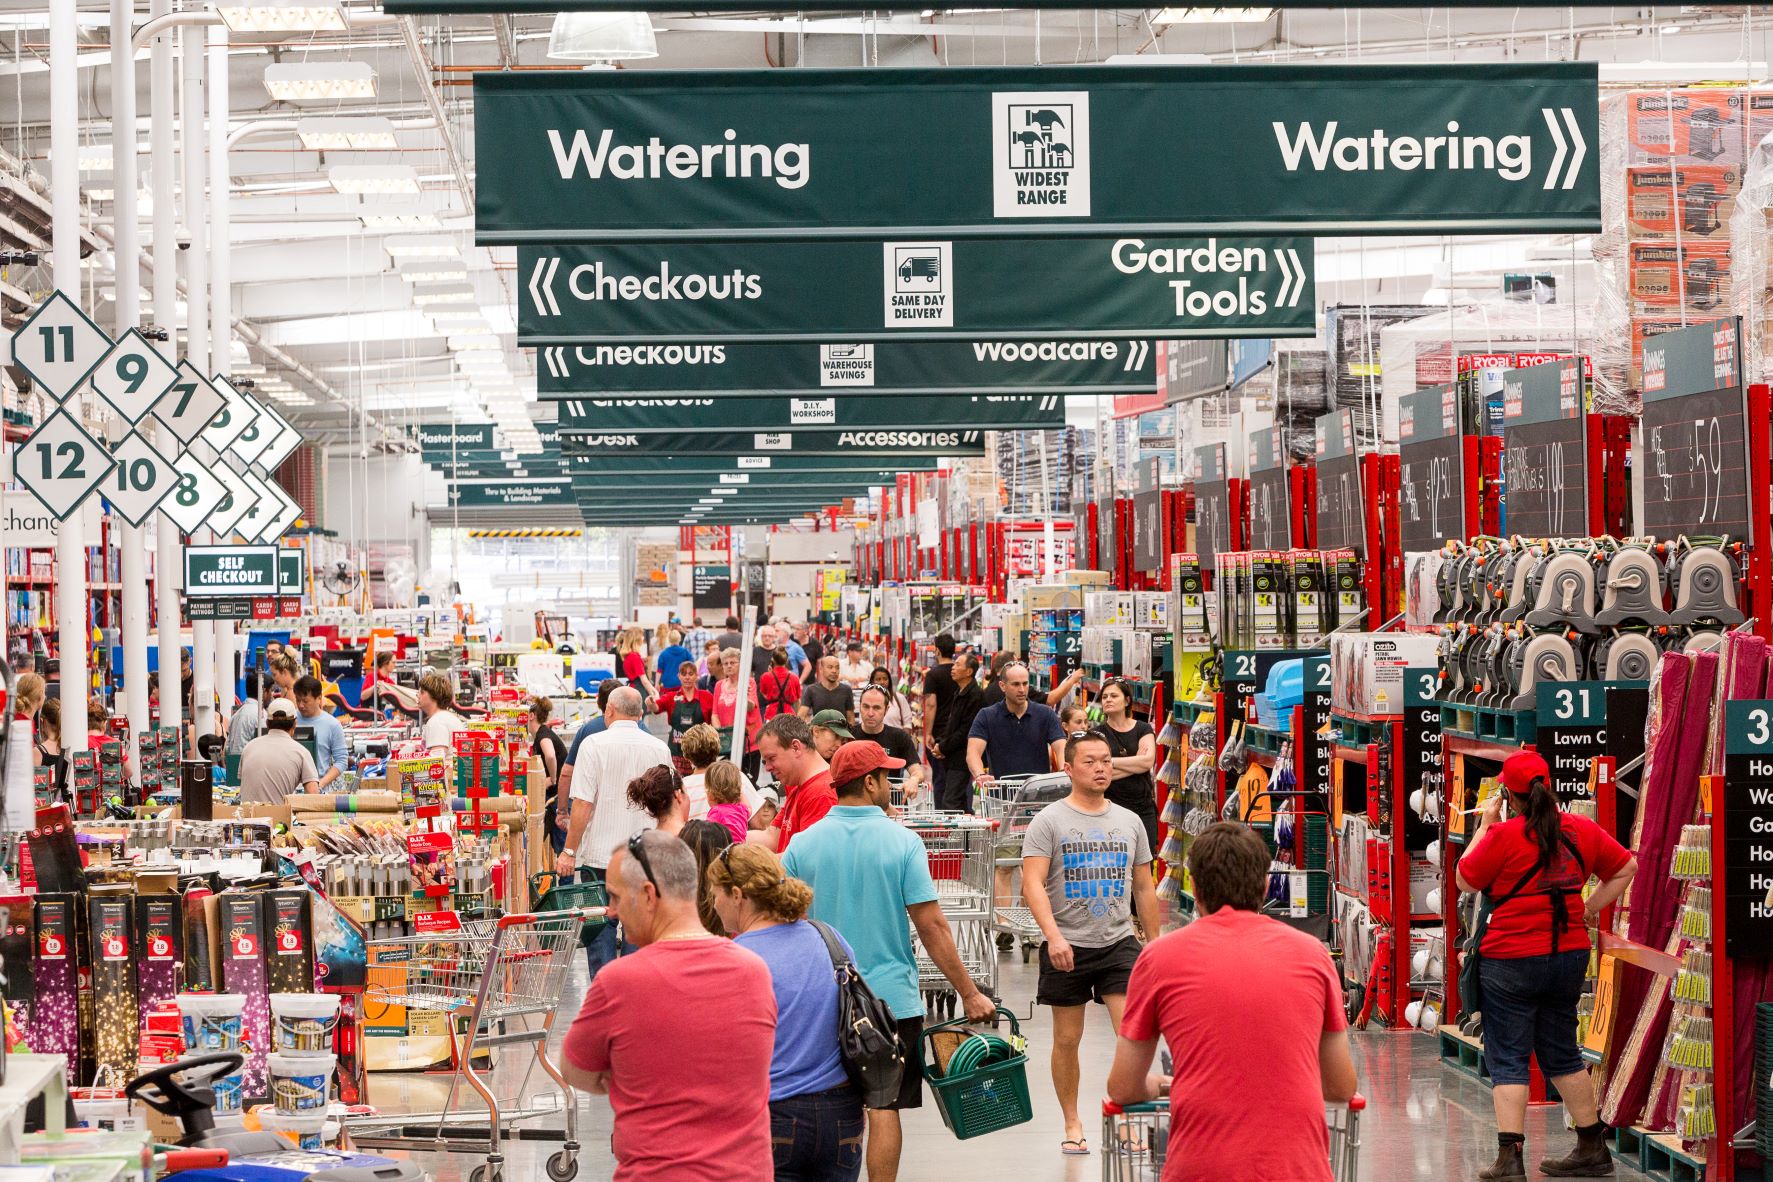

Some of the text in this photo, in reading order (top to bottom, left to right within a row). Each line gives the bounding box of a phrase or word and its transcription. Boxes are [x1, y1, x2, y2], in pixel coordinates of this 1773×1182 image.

[1641, 98, 1684, 110] jumbck
[1272, 120, 1533, 182] Watering
[546, 128, 810, 190] Watering
[1014, 170, 1070, 188] WIDEST
[1637, 175, 1681, 185] jumbuk
[1017, 189, 1068, 205] RANGE
[1111, 239, 1268, 274] Garden
[1638, 249, 1684, 260] jumbuc
[568, 261, 762, 300] Checkouts
[891, 294, 946, 306] SAME DAY
[1168, 280, 1268, 317] Tools
[894, 308, 943, 320] DELIVERY
[38, 326, 74, 363] 11
[972, 342, 1118, 362] Woodcare
[575, 346, 726, 366] Checkouts
[1474, 356, 1509, 368] RYOBI
[822, 360, 872, 370] WAREHOUSE
[116, 354, 149, 394] 9
[829, 370, 866, 380] SAVINGS
[172, 383, 198, 418] 7
[838, 431, 960, 446] Accessories
[36, 441, 86, 480] 12
[117, 458, 157, 492] 10
[176, 472, 200, 506] 8
[508, 488, 532, 496] Building
[510, 495, 543, 503] Landscape
[218, 556, 244, 570] SELF
[200, 570, 264, 584] CHECKOUT
[1317, 694, 1332, 706] Po
[1554, 688, 1590, 719] 31
[1420, 710, 1442, 722] Ga
[1554, 732, 1592, 745] Lawn
[1422, 752, 1444, 766] Dig
[1556, 778, 1589, 796] Irrig
